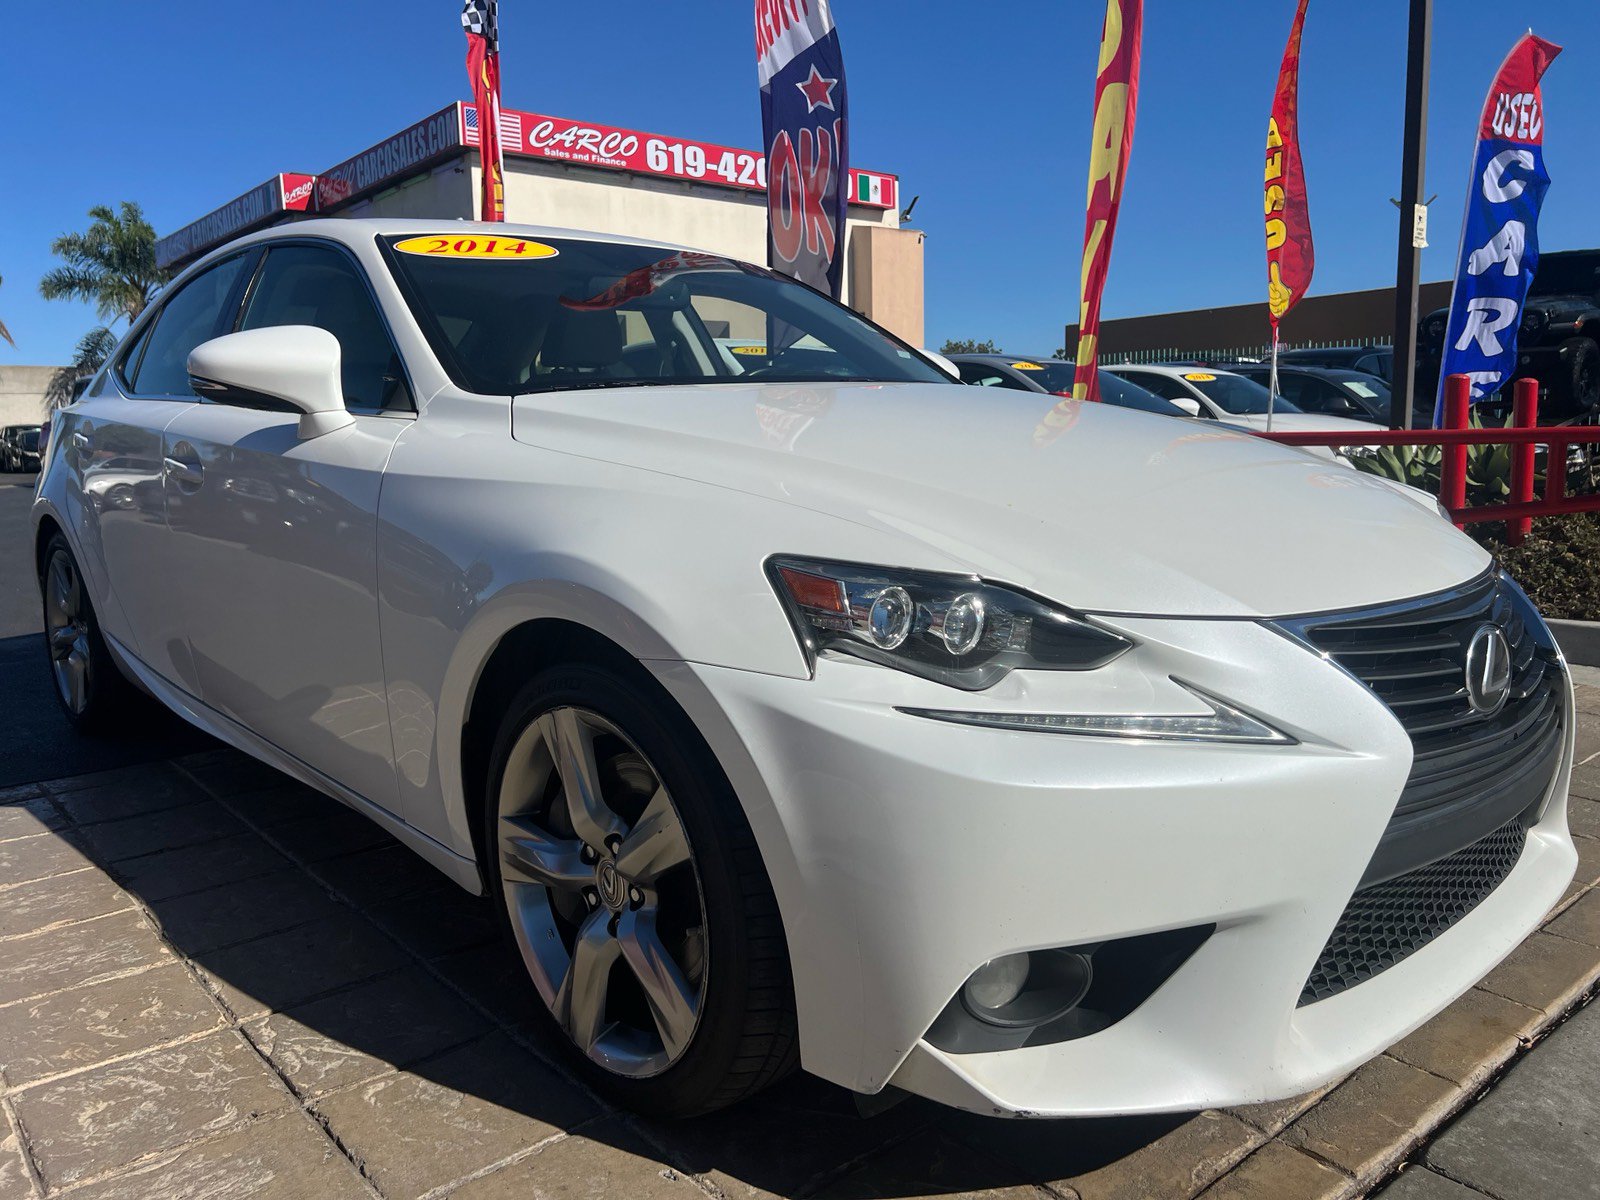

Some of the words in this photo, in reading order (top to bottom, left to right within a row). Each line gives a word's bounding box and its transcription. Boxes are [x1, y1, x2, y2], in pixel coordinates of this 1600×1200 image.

[356, 109, 458, 189] CARCOSALES.COM
[529, 120, 639, 158] CARCO
[544, 147, 571, 159] Sales
[572, 152, 590, 161] and
[591, 154, 627, 167] Finance
[284, 180, 313, 203] CARCO
[1264, 116, 1287, 251] USED
[426, 238, 528, 255] 2014
